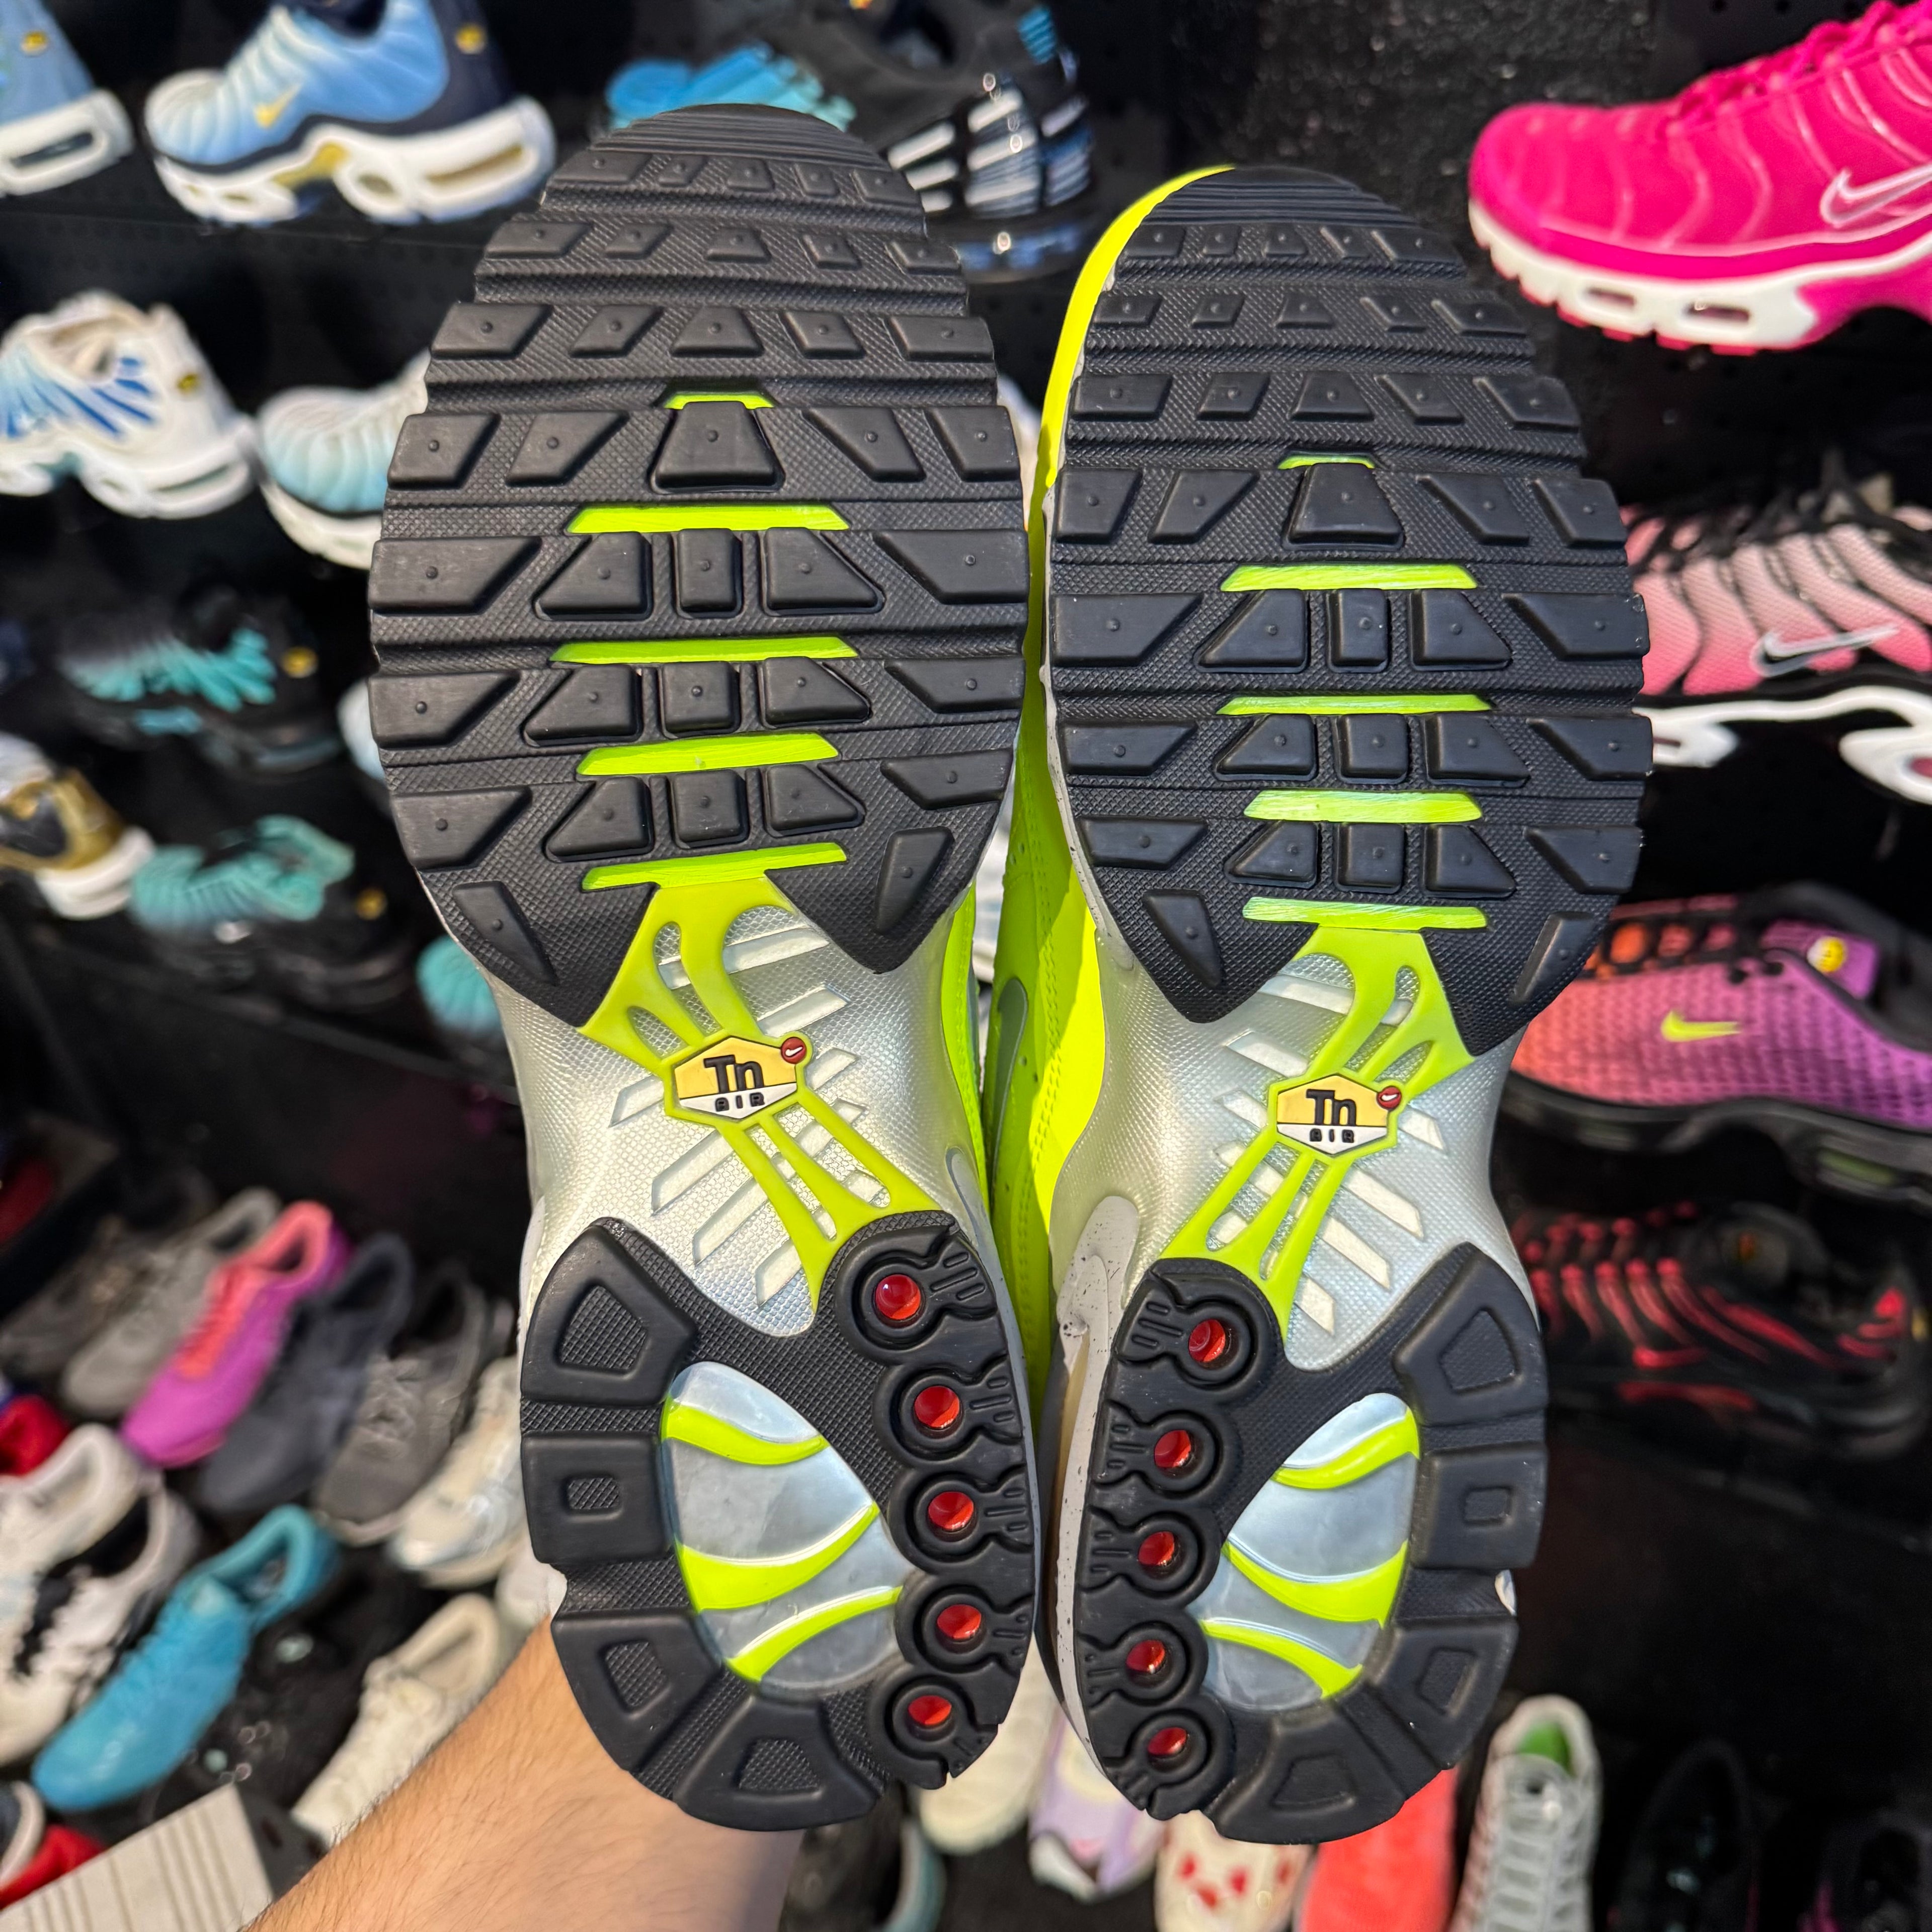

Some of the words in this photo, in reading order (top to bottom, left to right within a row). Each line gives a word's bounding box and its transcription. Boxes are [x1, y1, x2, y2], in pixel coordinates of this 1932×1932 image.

[703, 1054, 765, 1093] Tn
[714, 1092, 765, 1112] AIR
[1306, 1088, 1357, 1126] Tn
